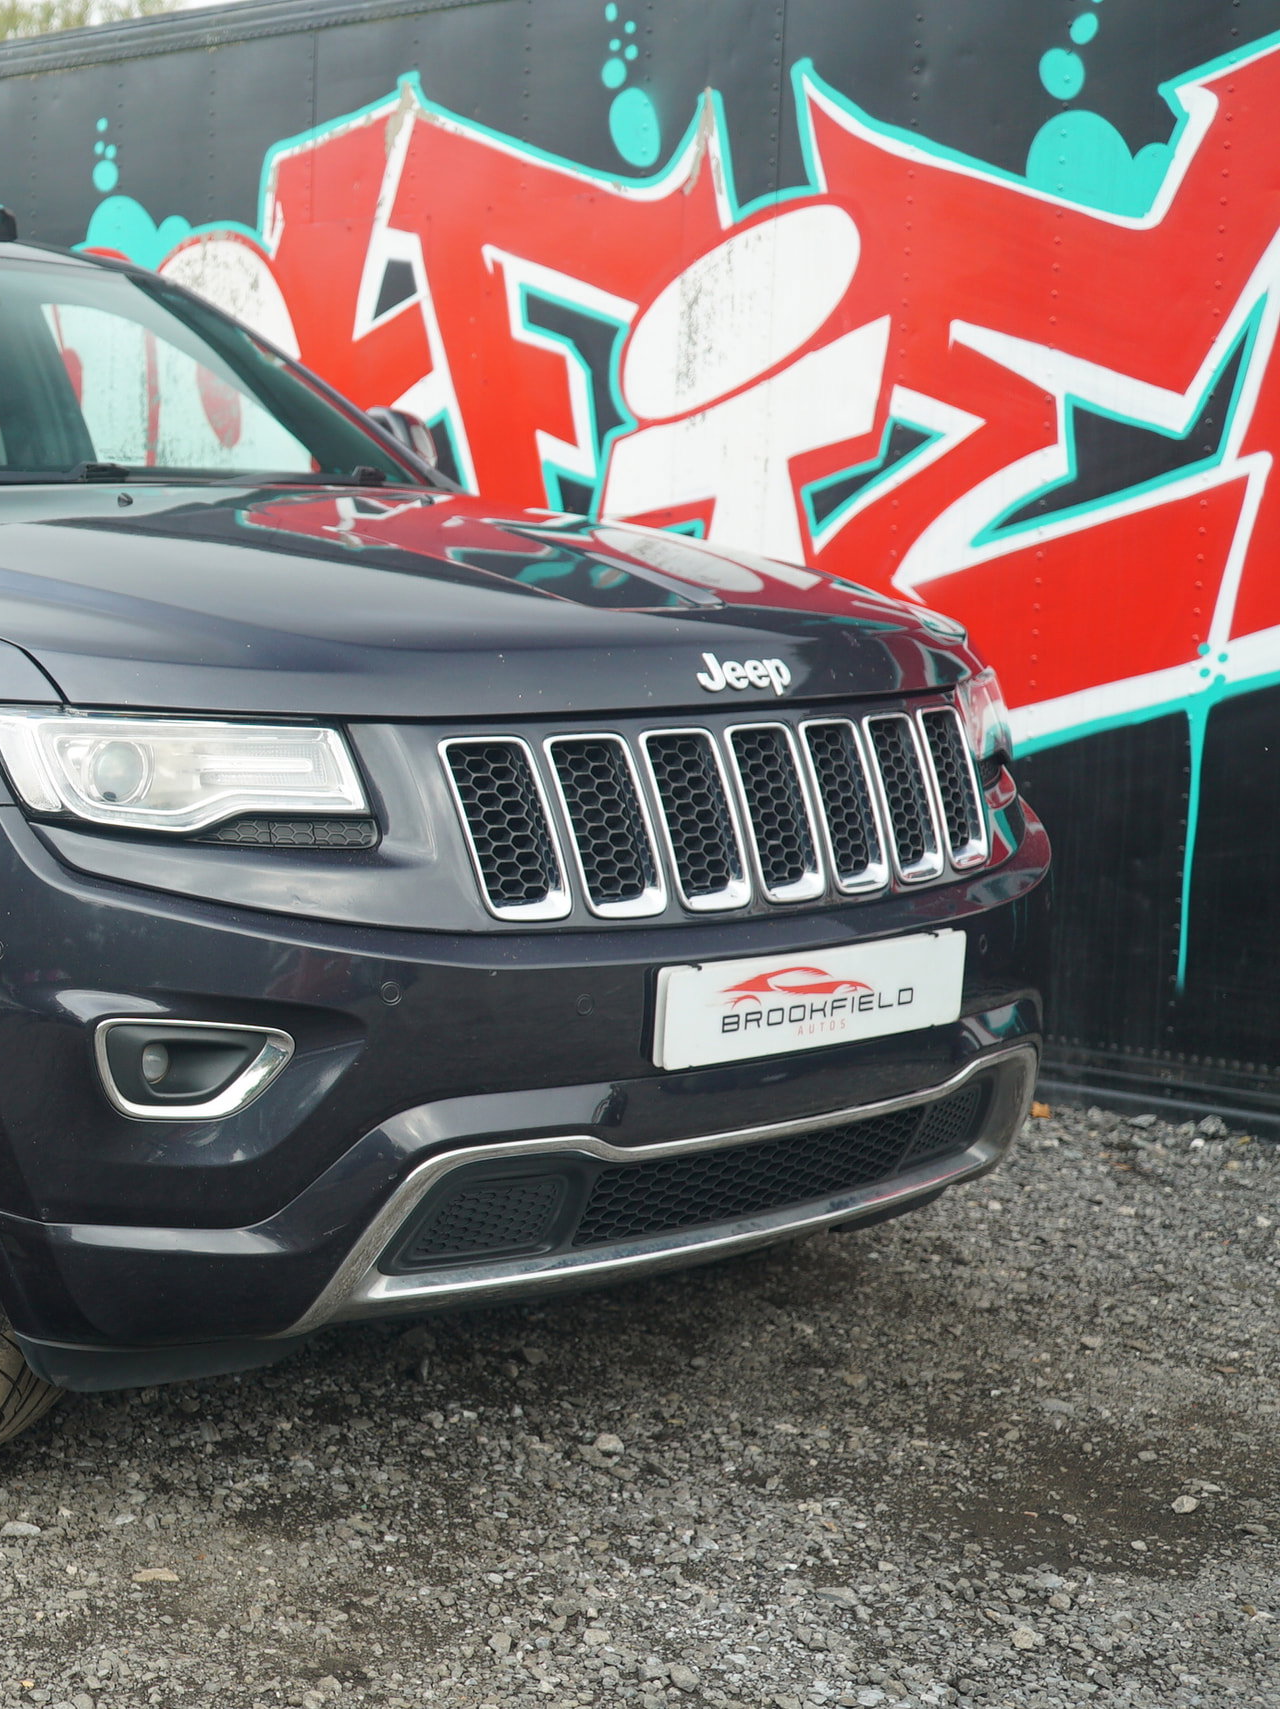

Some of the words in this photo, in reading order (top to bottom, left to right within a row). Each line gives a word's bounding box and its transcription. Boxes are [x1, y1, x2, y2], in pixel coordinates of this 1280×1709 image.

[696, 652, 792, 697] Jeep
[721, 986, 915, 1034] BROOKFIELD
[796, 1017, 847, 1037] AUTOS
